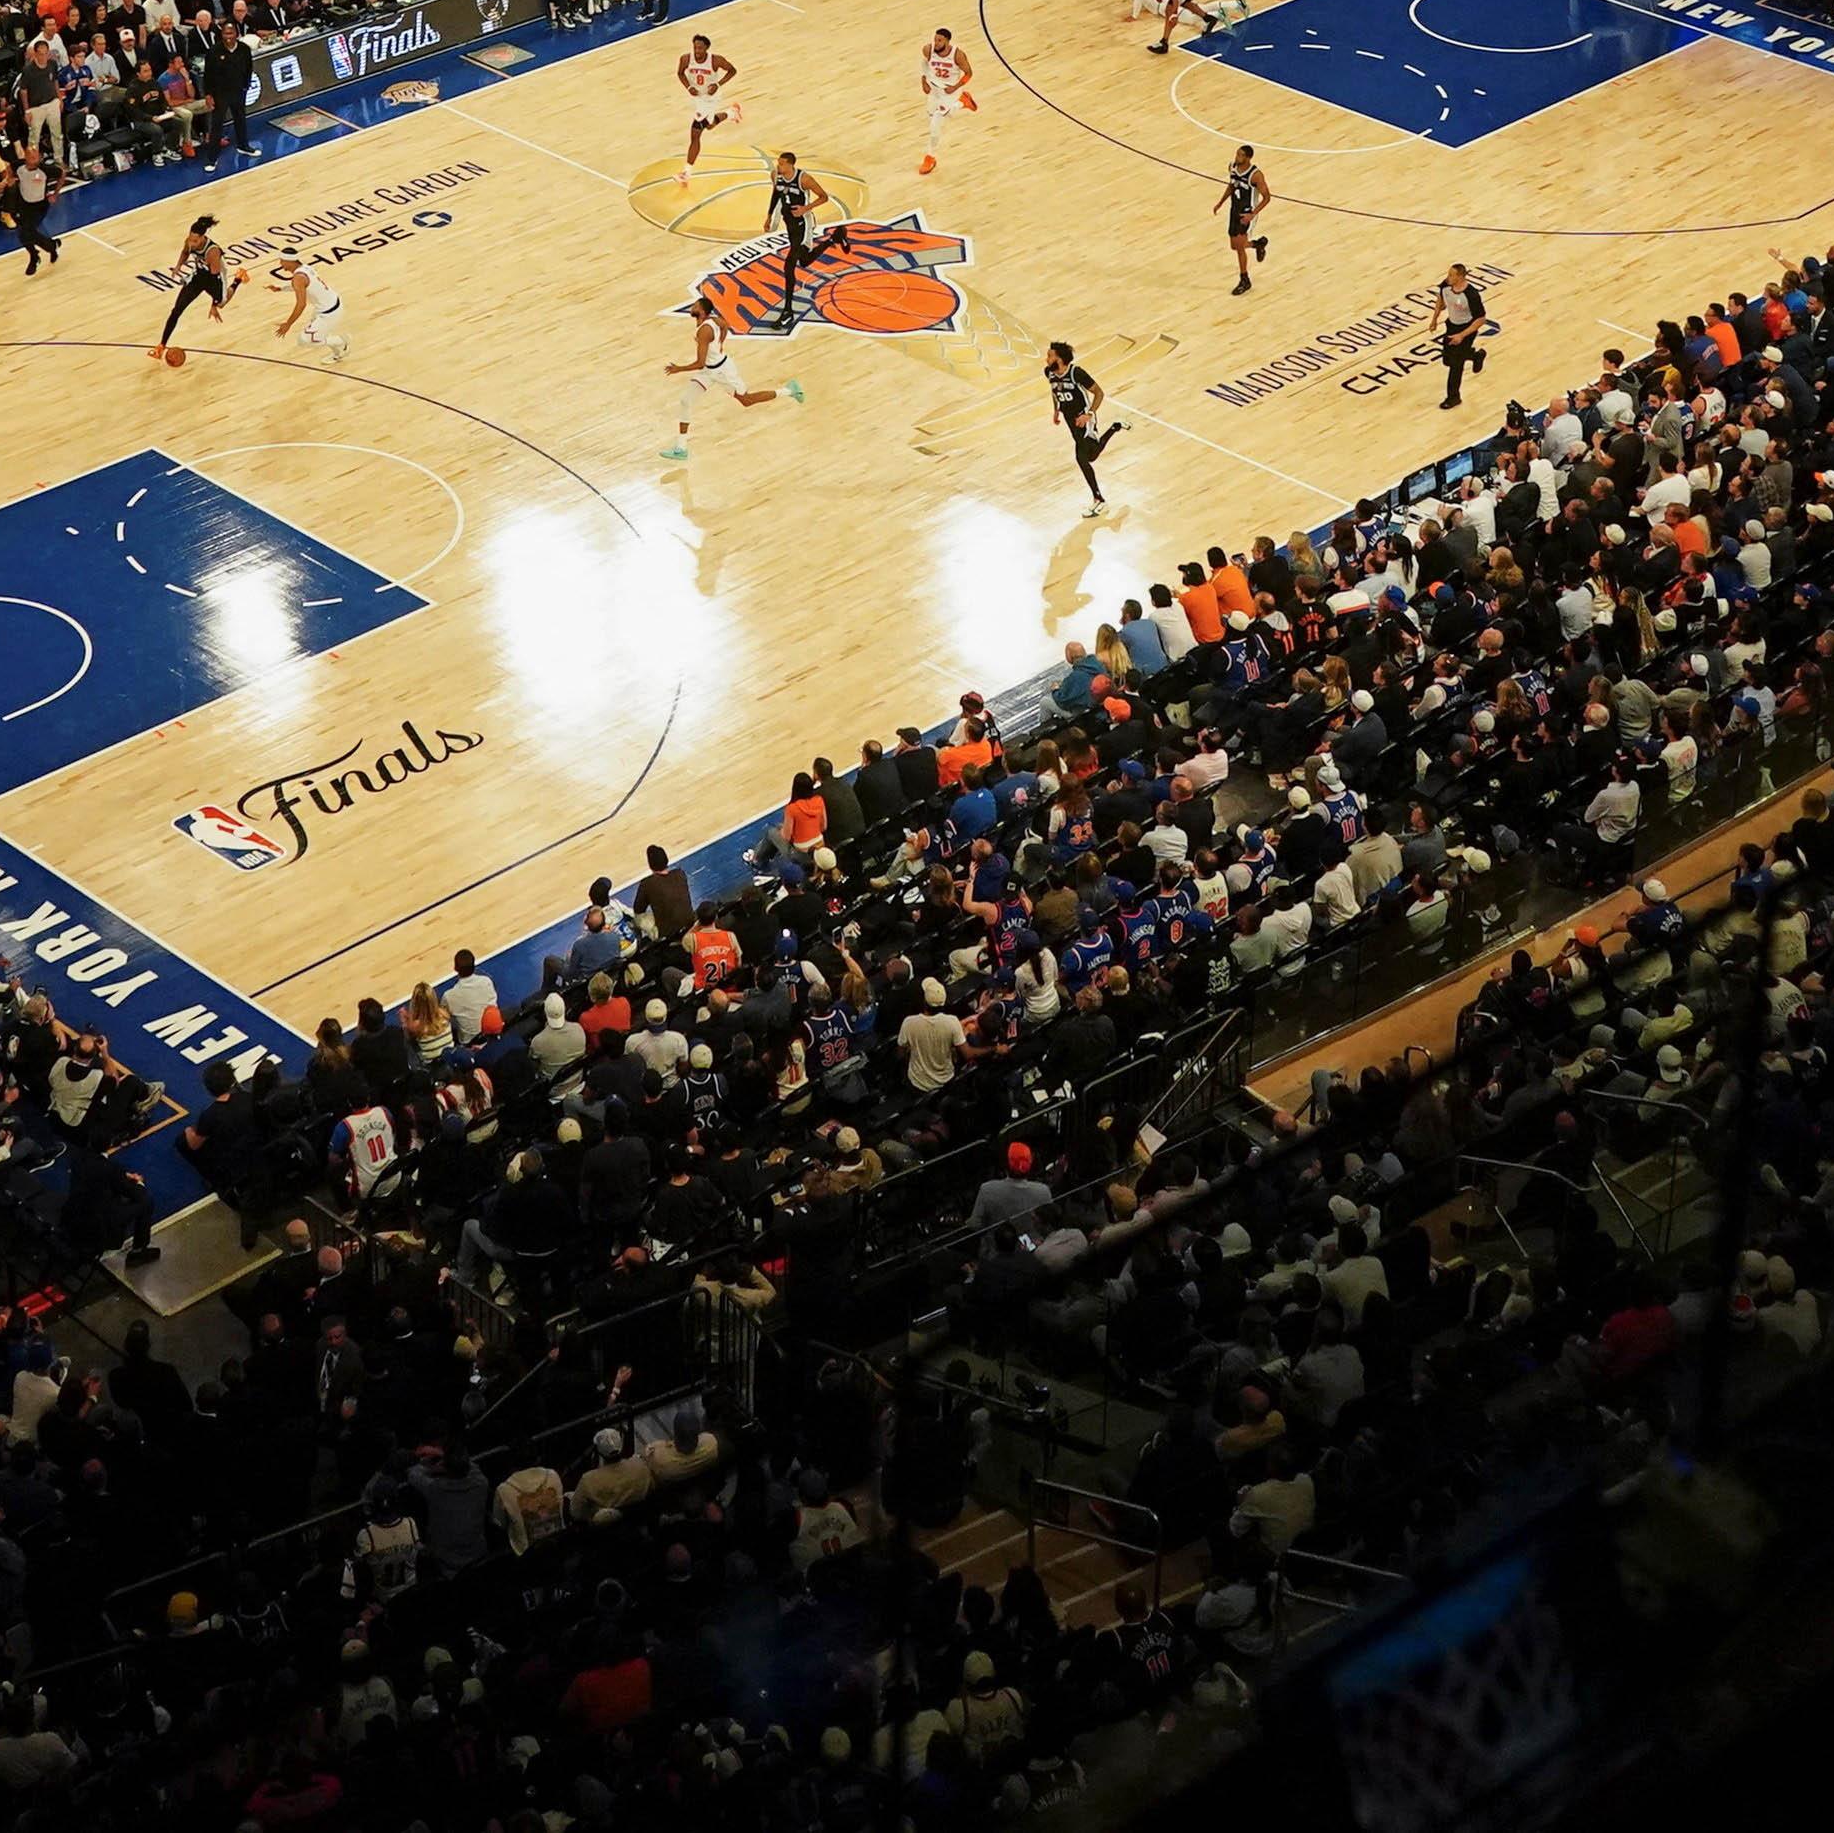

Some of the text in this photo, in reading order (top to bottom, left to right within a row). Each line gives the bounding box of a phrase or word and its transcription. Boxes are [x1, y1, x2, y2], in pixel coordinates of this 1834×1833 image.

[347, 10, 442, 77] Finals
[267, 198, 387, 244] SQUARE
[373, 161, 491, 207] GARDEN
[719, 243, 761, 271] NEW
[1205, 346, 1339, 408] MADISON
[1315, 303, 1428, 354] SQUARE
[1340, 332, 1450, 395] CHAS
[1056, 391, 1075, 402] 30
[237, 719, 486, 869] Finals
[1340, 817, 1357, 844] 11
[236, 848, 270, 869] NBA
[703, 958, 728, 986] 21
[141, 1002, 283, 1084] NEW
[819, 1037, 849, 1068] 32
[366, 1133, 388, 1164] 11
